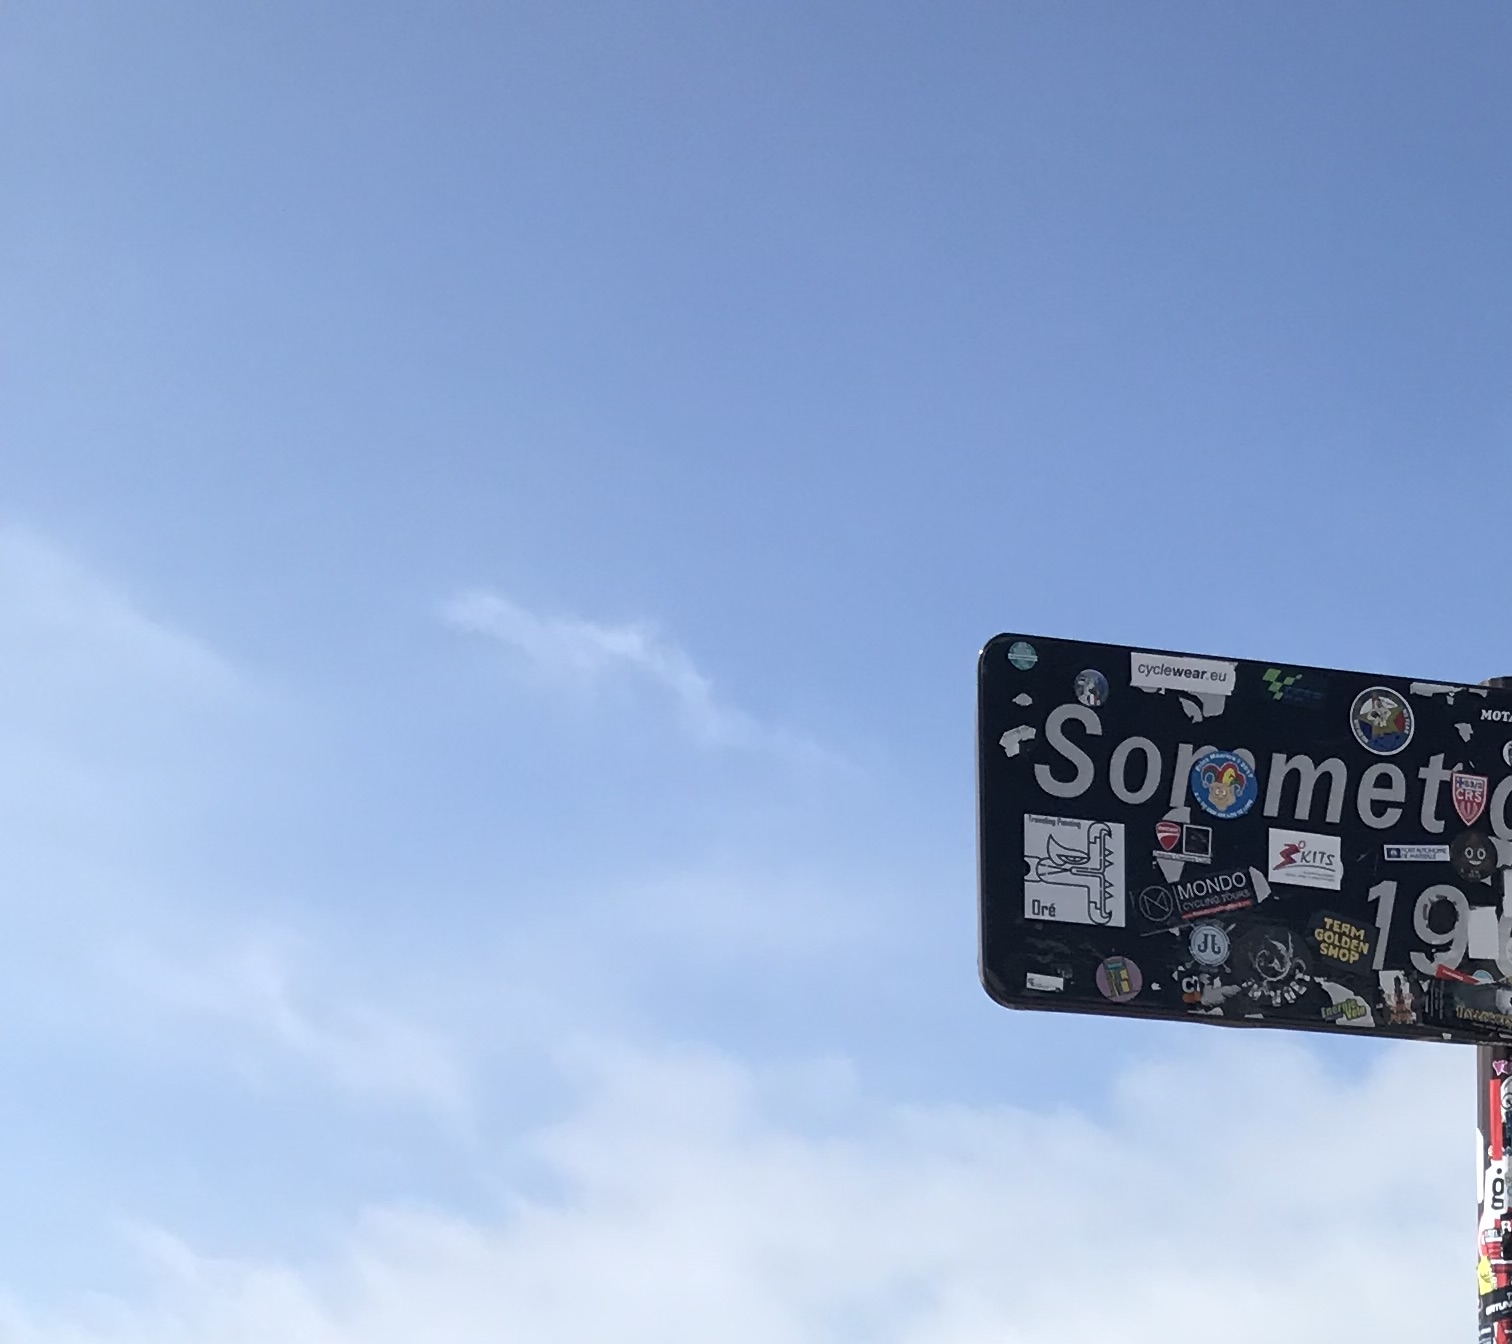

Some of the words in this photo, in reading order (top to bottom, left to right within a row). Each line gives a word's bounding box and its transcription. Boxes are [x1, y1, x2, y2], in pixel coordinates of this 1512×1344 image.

[1137, 662, 1228, 683] cyclewear.eu
[1456, 789, 1484, 802] CRS
[1300, 850, 1335, 866] KITS
[1178, 871, 1247, 900] MONDO
[1031, 899, 1056, 917] Oré
[1324, 917, 1365, 939] TEAM
[1314, 929, 1369, 955] GOLDEN
[1319, 943, 1359, 963] SHOP
